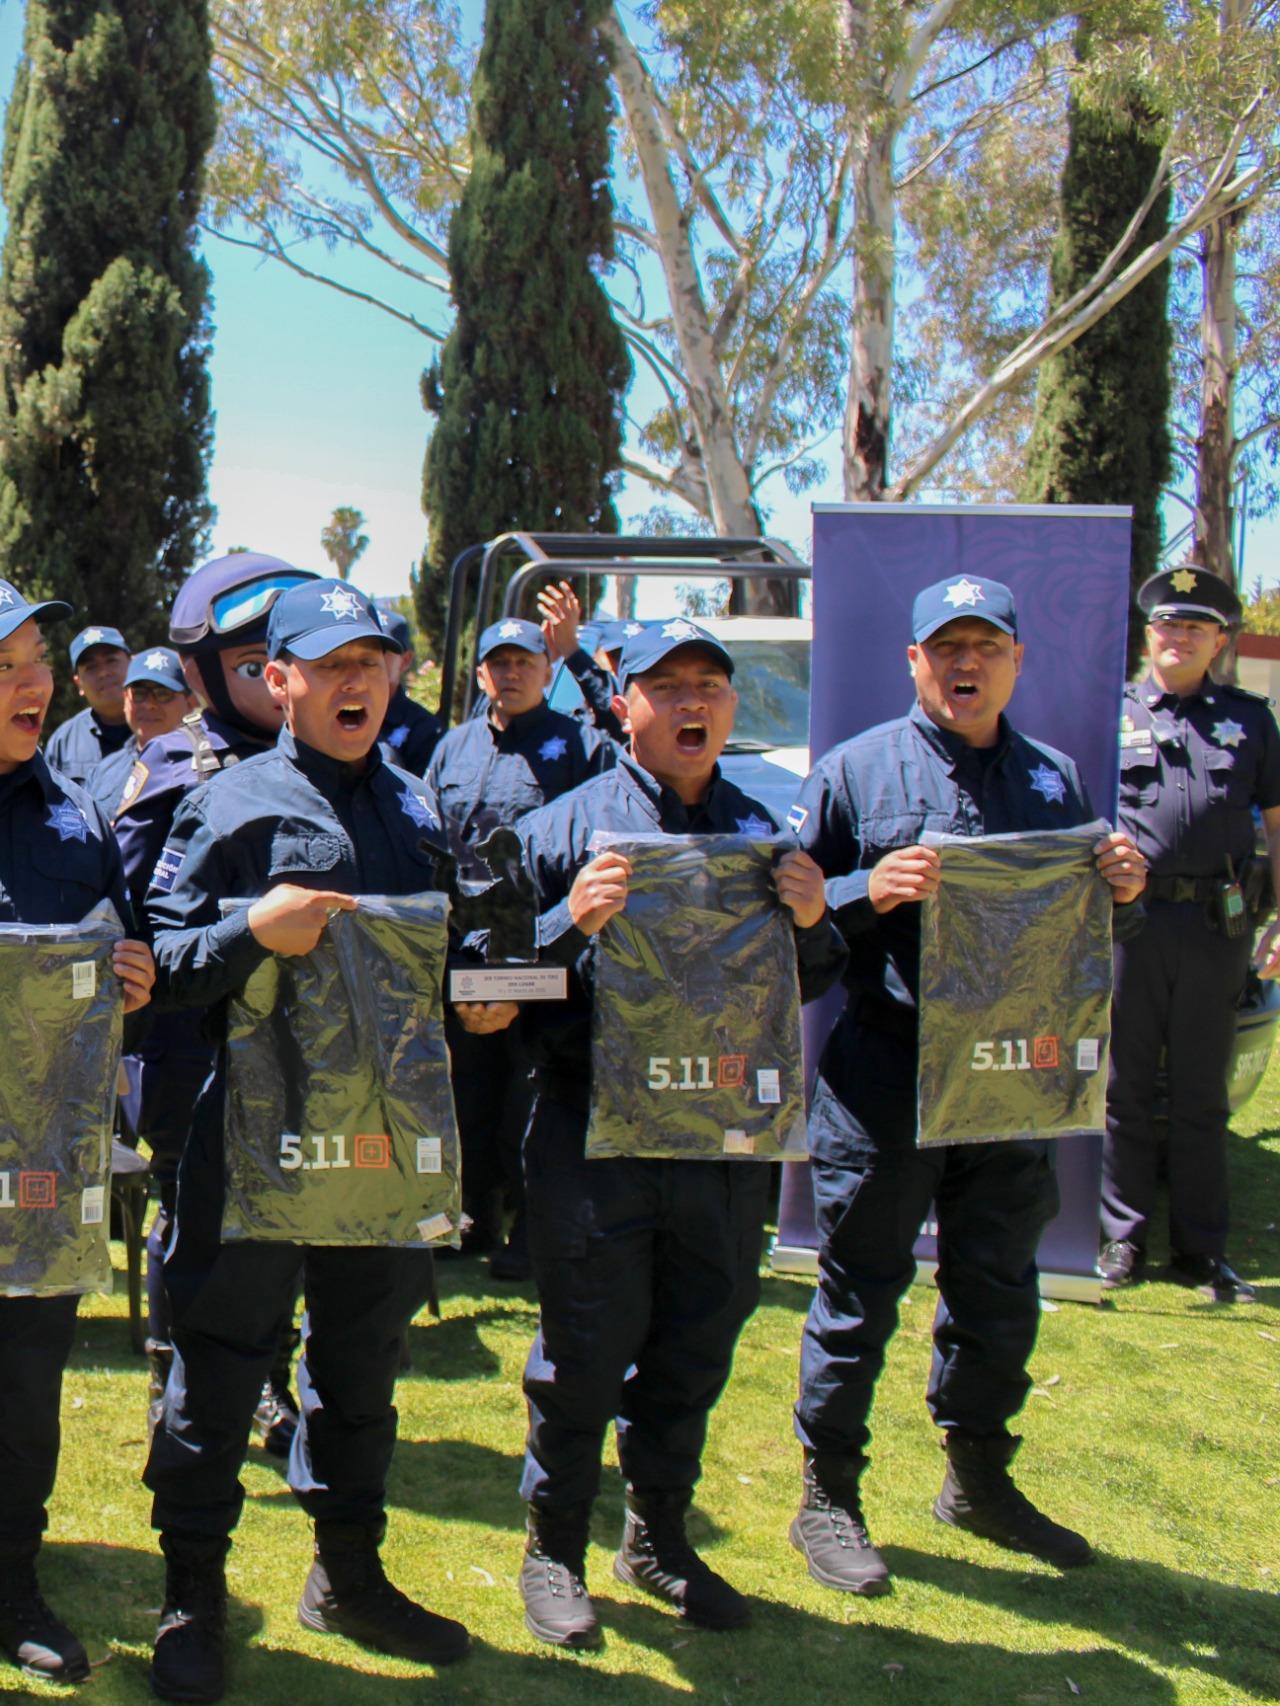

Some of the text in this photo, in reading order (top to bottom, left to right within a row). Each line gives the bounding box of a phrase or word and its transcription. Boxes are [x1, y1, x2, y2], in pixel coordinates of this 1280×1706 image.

[971, 1039, 1031, 1071] 5.11
[648, 1056, 714, 1090] 5.11
[279, 1135, 351, 1170] 5.11
